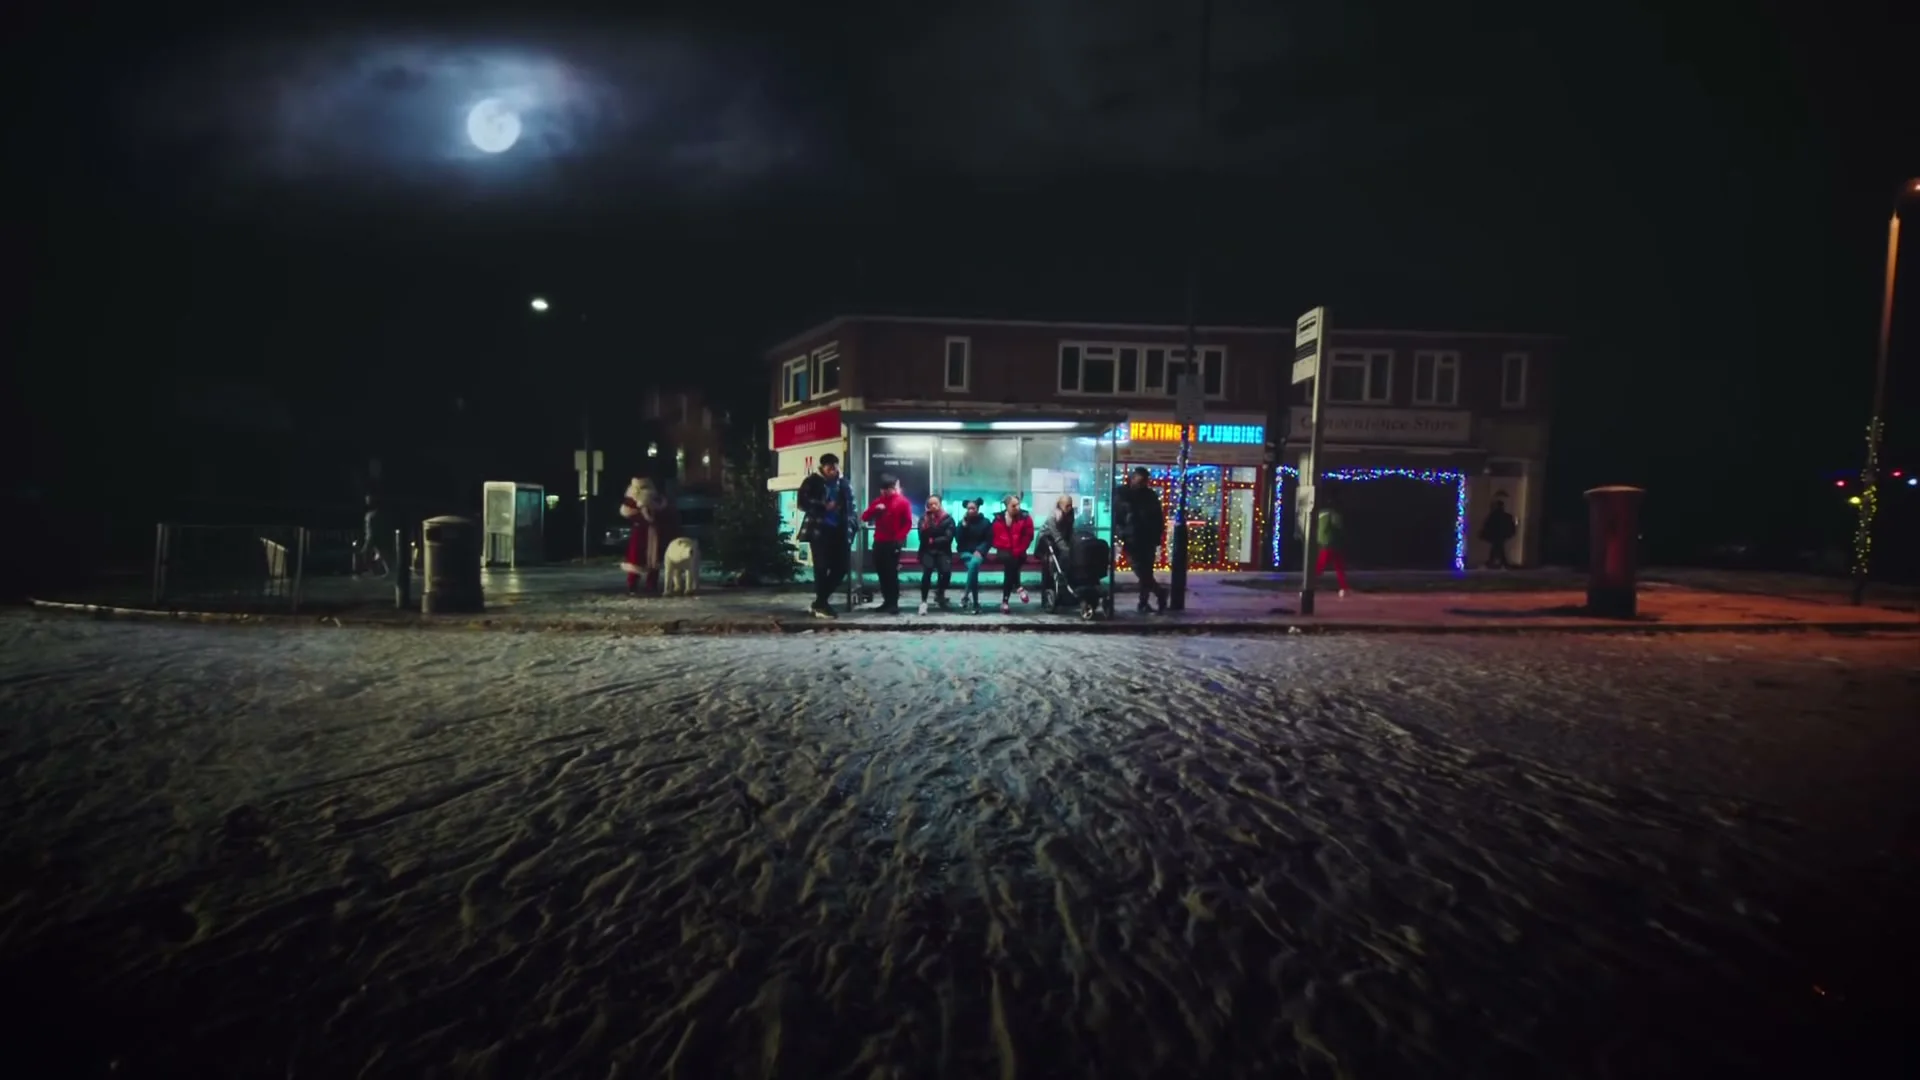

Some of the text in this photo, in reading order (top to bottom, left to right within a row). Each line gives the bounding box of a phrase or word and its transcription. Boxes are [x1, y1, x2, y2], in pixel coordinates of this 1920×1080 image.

[1130, 421, 1183, 441] HEATING
[1197, 424, 1264, 444] PLUMBING
[1300, 414, 1460, 432] Cnvenience Store
